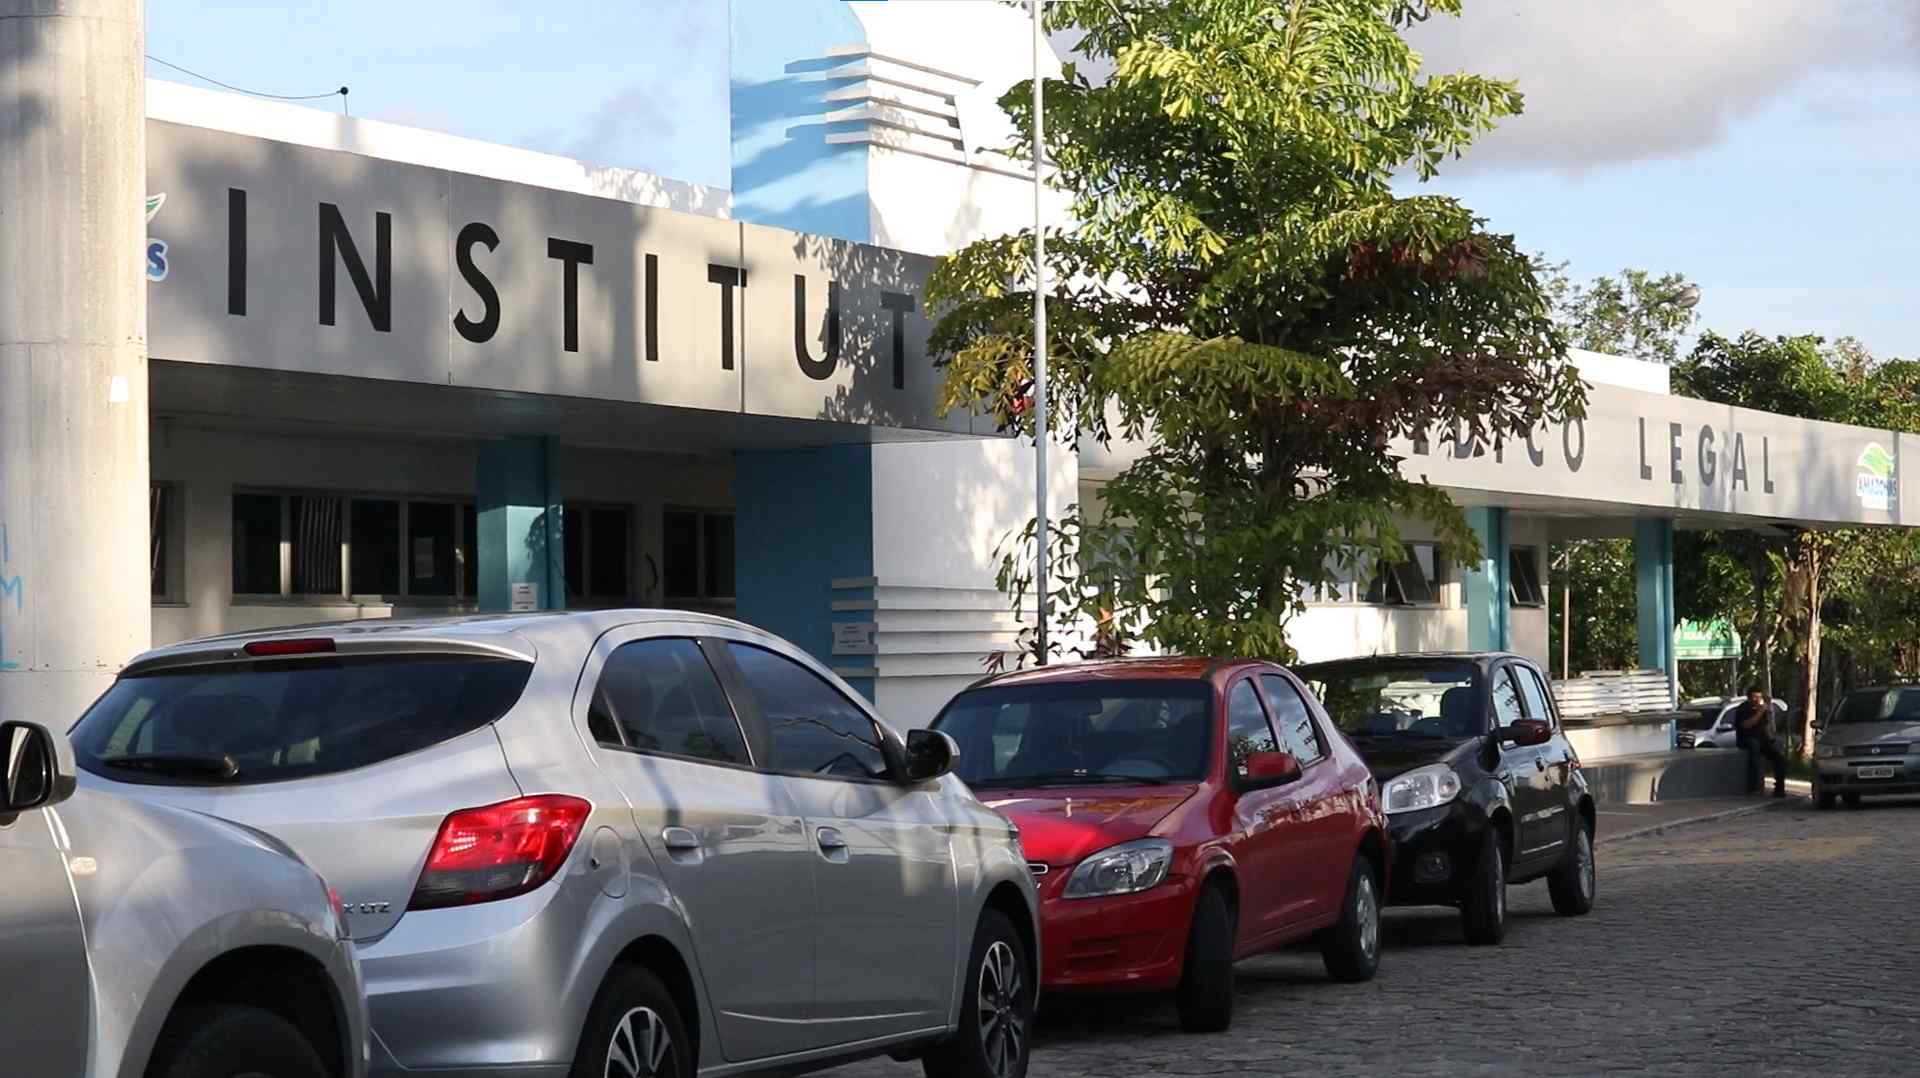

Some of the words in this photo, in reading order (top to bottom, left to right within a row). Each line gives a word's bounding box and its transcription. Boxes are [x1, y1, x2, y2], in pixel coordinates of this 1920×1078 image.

[146, 242, 166, 277] S
[228, 187, 915, 391] INSTITUT
[1639, 416, 1774, 494] LEGAL
[360, 901, 390, 914] LTZ
